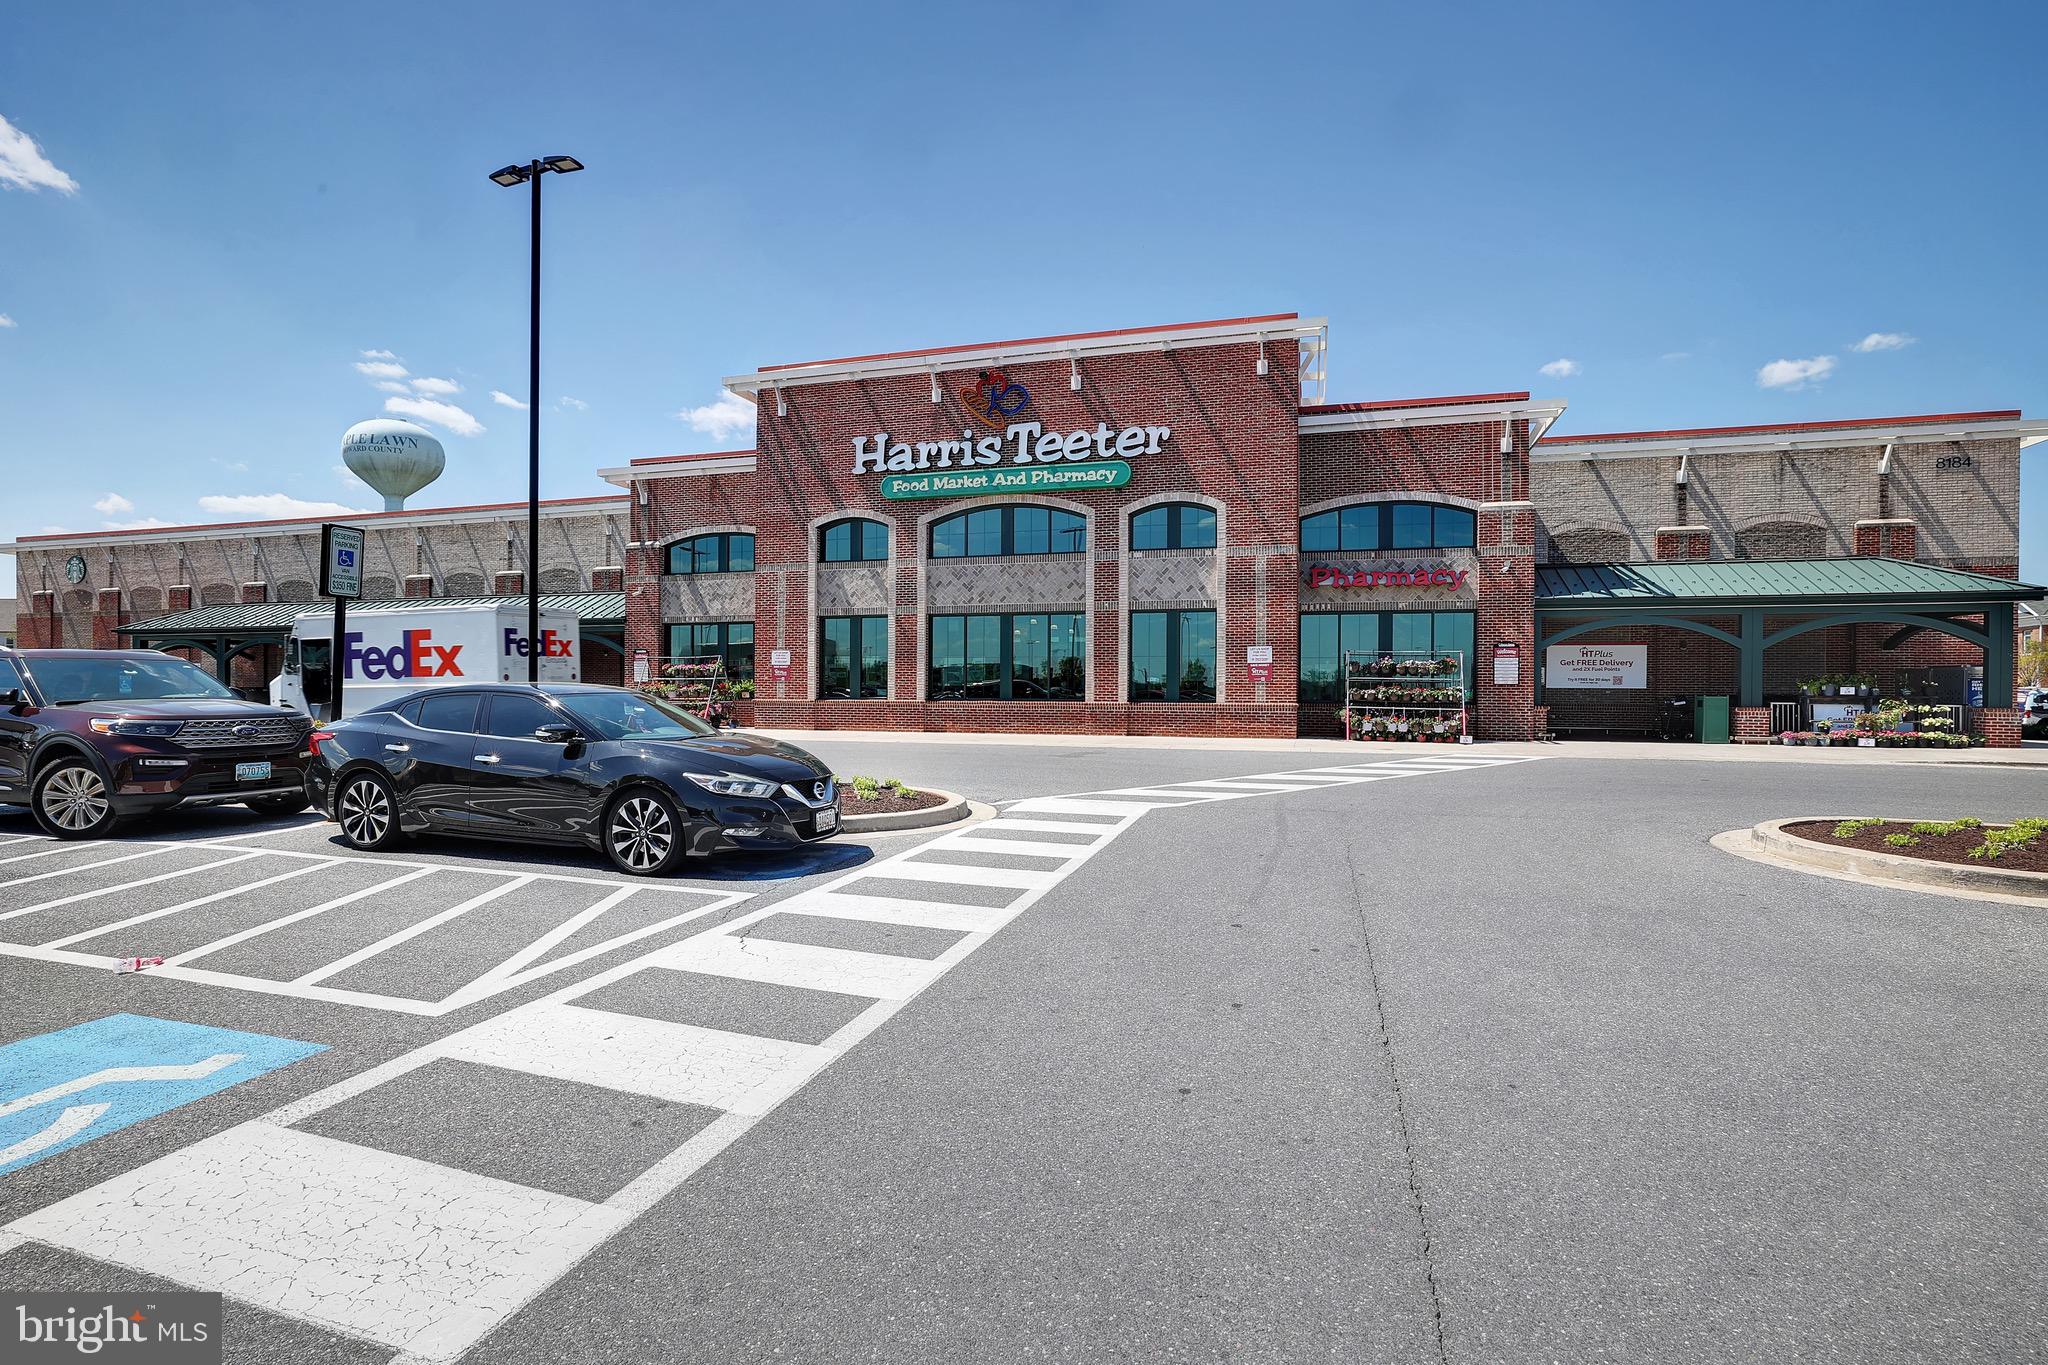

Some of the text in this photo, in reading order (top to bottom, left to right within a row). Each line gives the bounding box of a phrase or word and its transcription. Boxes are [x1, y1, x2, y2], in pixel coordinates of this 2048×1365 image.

[343, 433, 418, 449] PLE LAWN
[368, 445, 404, 454] COUNTY
[850, 421, 1171, 475] Harris Teeter
[1936, 456, 1972, 469] 8184
[892, 468, 1118, 493] Food Market And Pharmacy
[333, 532, 361, 542] RESERVED
[335, 540, 359, 550] PARKING
[1310, 567, 1469, 591] Pharmacy
[332, 580, 358, 592] $350 FINE
[504, 627, 574, 658] FedEx
[344, 628, 465, 680] FedEx
[1581, 650, 1614, 658] HTPlus
[1599, 660, 1634, 668] Delivery
